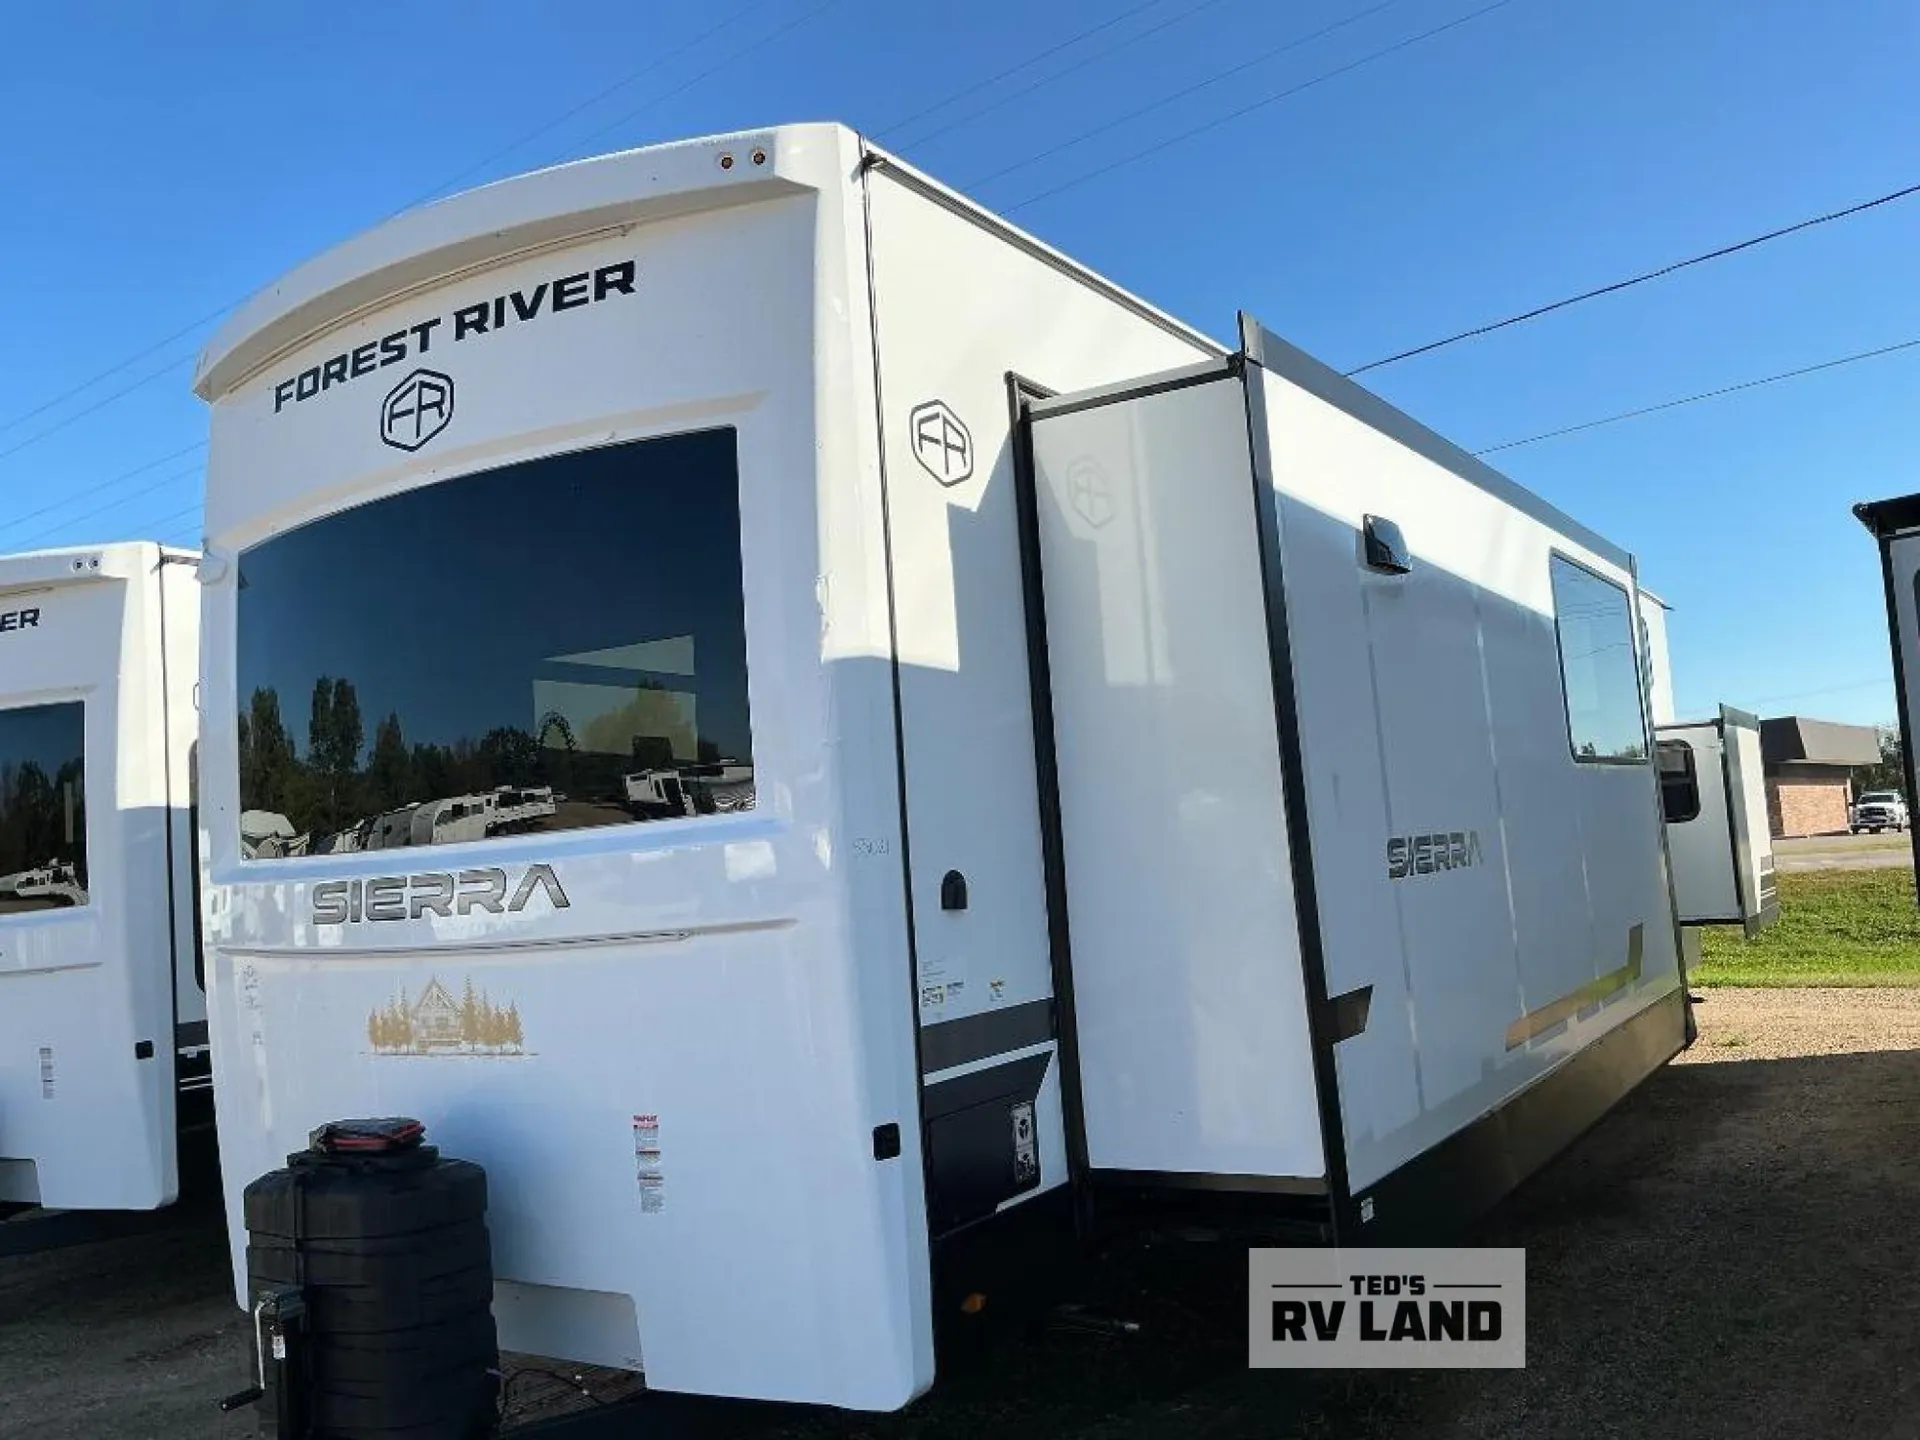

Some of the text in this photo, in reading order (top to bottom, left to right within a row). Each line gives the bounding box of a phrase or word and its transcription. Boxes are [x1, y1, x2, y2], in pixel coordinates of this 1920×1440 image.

[275, 260, 635, 413] FOREST RIVER
[0, 608, 40, 632] ER
[1387, 831, 1483, 879] SIERRA
[313, 863, 570, 925] SIERRA
